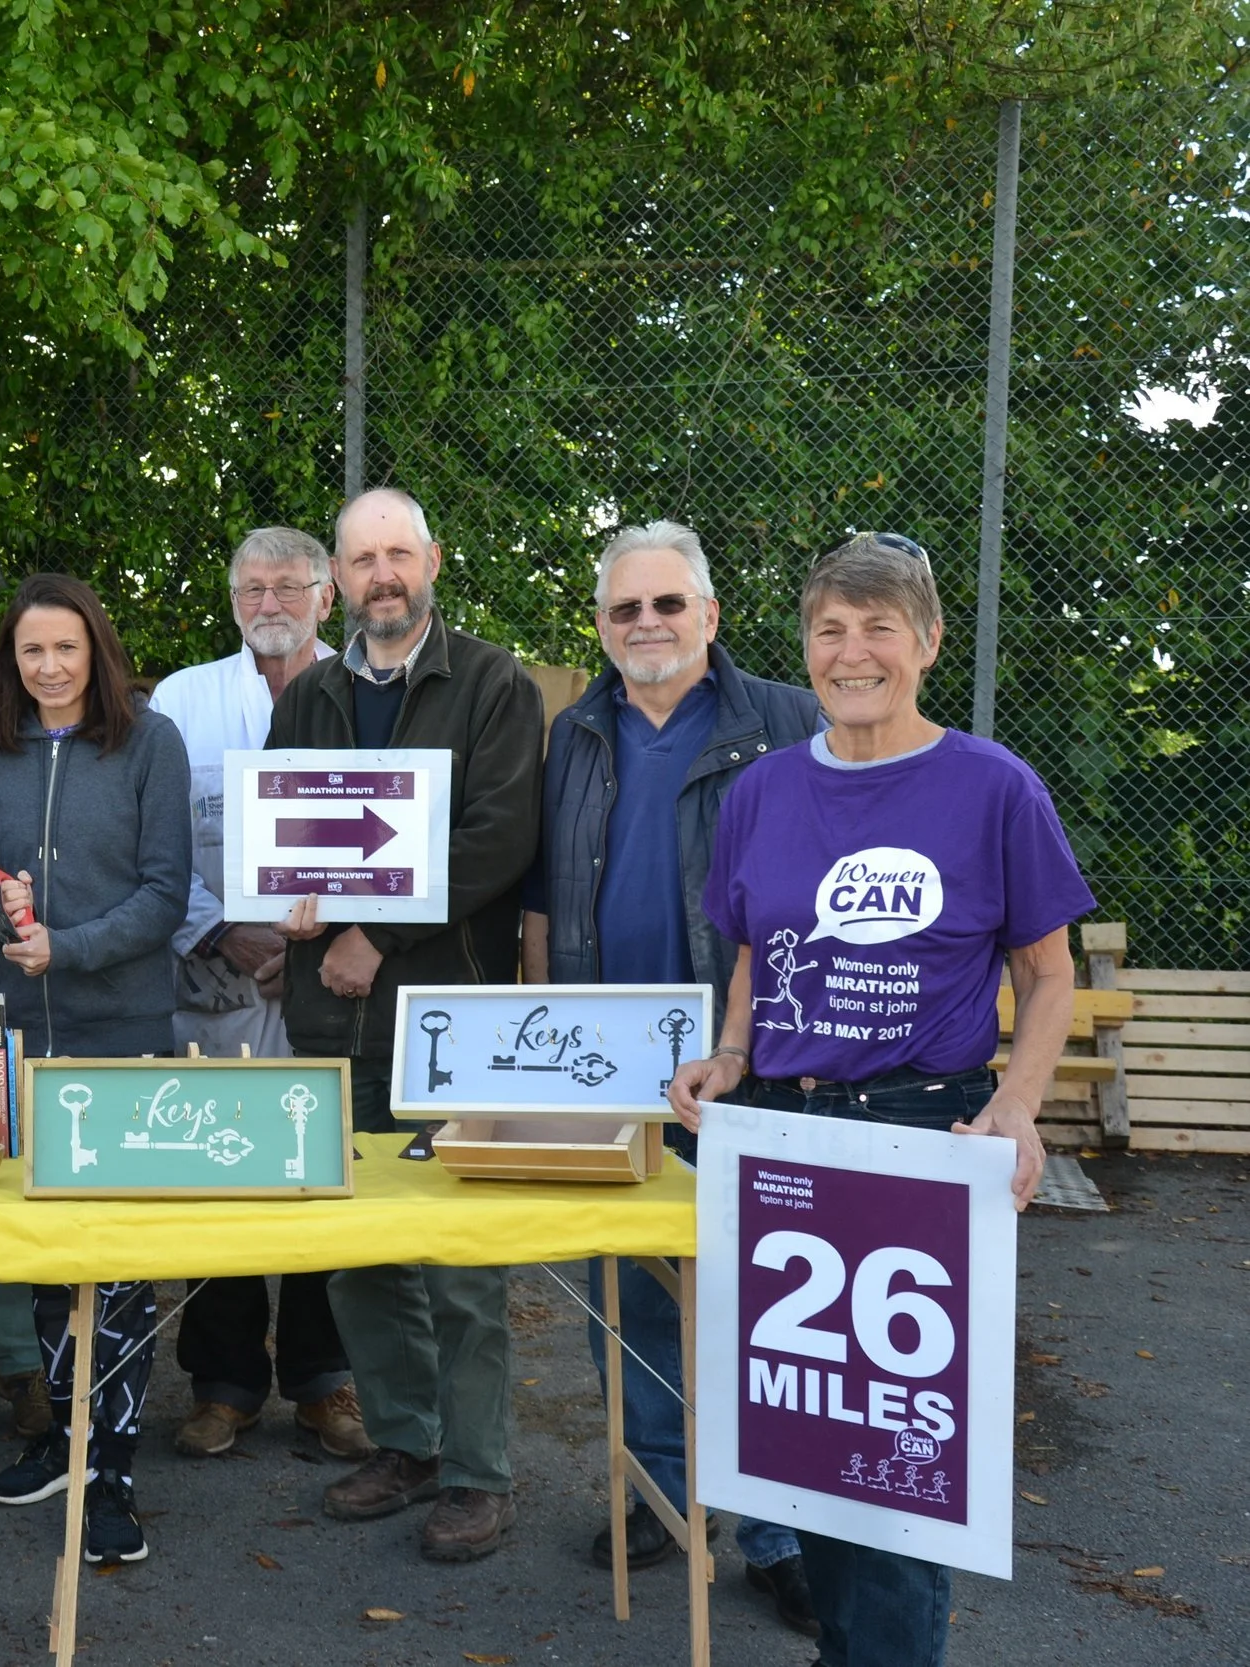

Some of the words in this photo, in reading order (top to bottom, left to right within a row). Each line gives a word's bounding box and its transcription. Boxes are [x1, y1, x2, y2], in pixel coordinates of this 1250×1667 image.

[297, 787, 344, 795] MARATHON
[346, 787, 374, 795] ROUTE
[297, 871, 324, 879] ROUTE
[327, 872, 373, 880] MARATHON
[835, 862, 925, 884] Women
[829, 885, 922, 916] CAN
[832, 956, 883, 975] Women
[888, 962, 919, 978] only
[825, 975, 919, 995] MARATHON
[829, 995, 865, 1013] tipton
[869, 1001, 884, 1014] st
[886, 1000, 917, 1016] john
[813, 1021, 832, 1035] 28
[835, 1023, 873, 1041] MAY
[878, 1023, 913, 1041] 2017
[758, 1170, 791, 1183] Women
[793, 1177, 813, 1188] only
[753, 1181, 813, 1198] MARATHON
[760, 1194, 783, 1205] tipton
[785, 1198, 793, 1207] st
[794, 1199, 813, 1210] john
[750, 1230, 956, 1379] 26
[749, 1357, 956, 1441] MILES
[901, 1432, 933, 1444] Women
[900, 1440, 934, 1456] CAN
